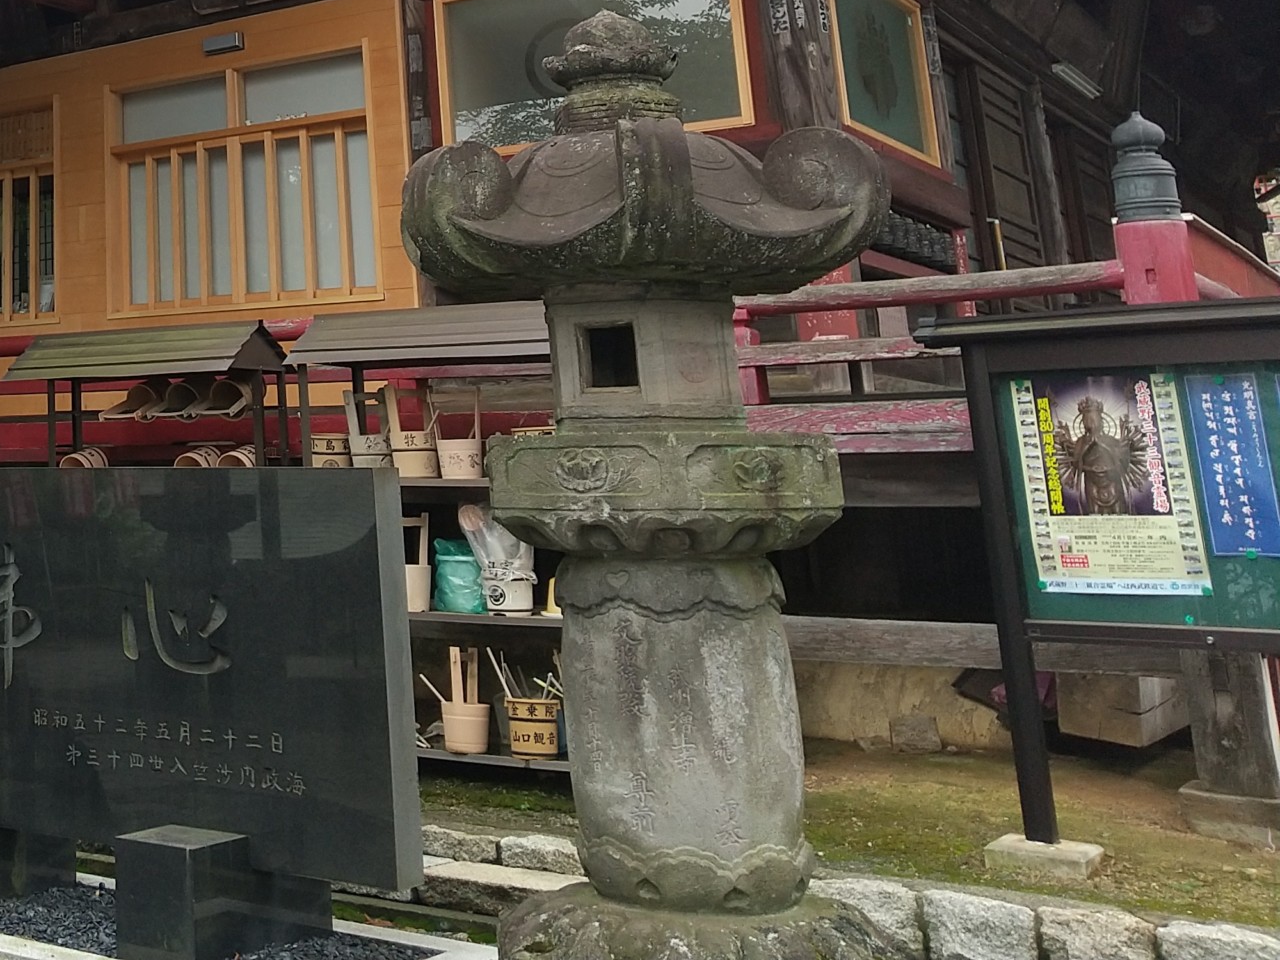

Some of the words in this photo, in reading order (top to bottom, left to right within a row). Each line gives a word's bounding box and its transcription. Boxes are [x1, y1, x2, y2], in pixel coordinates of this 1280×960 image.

[1242, 381, 1257, 420] 光明真言
[1134, 380, 1171, 513] 武蔵野三十三観音霊場
[33, 707, 285, 754] 昭和五十二年五月二十二日
[513, 730, 556, 746] 山口観音
